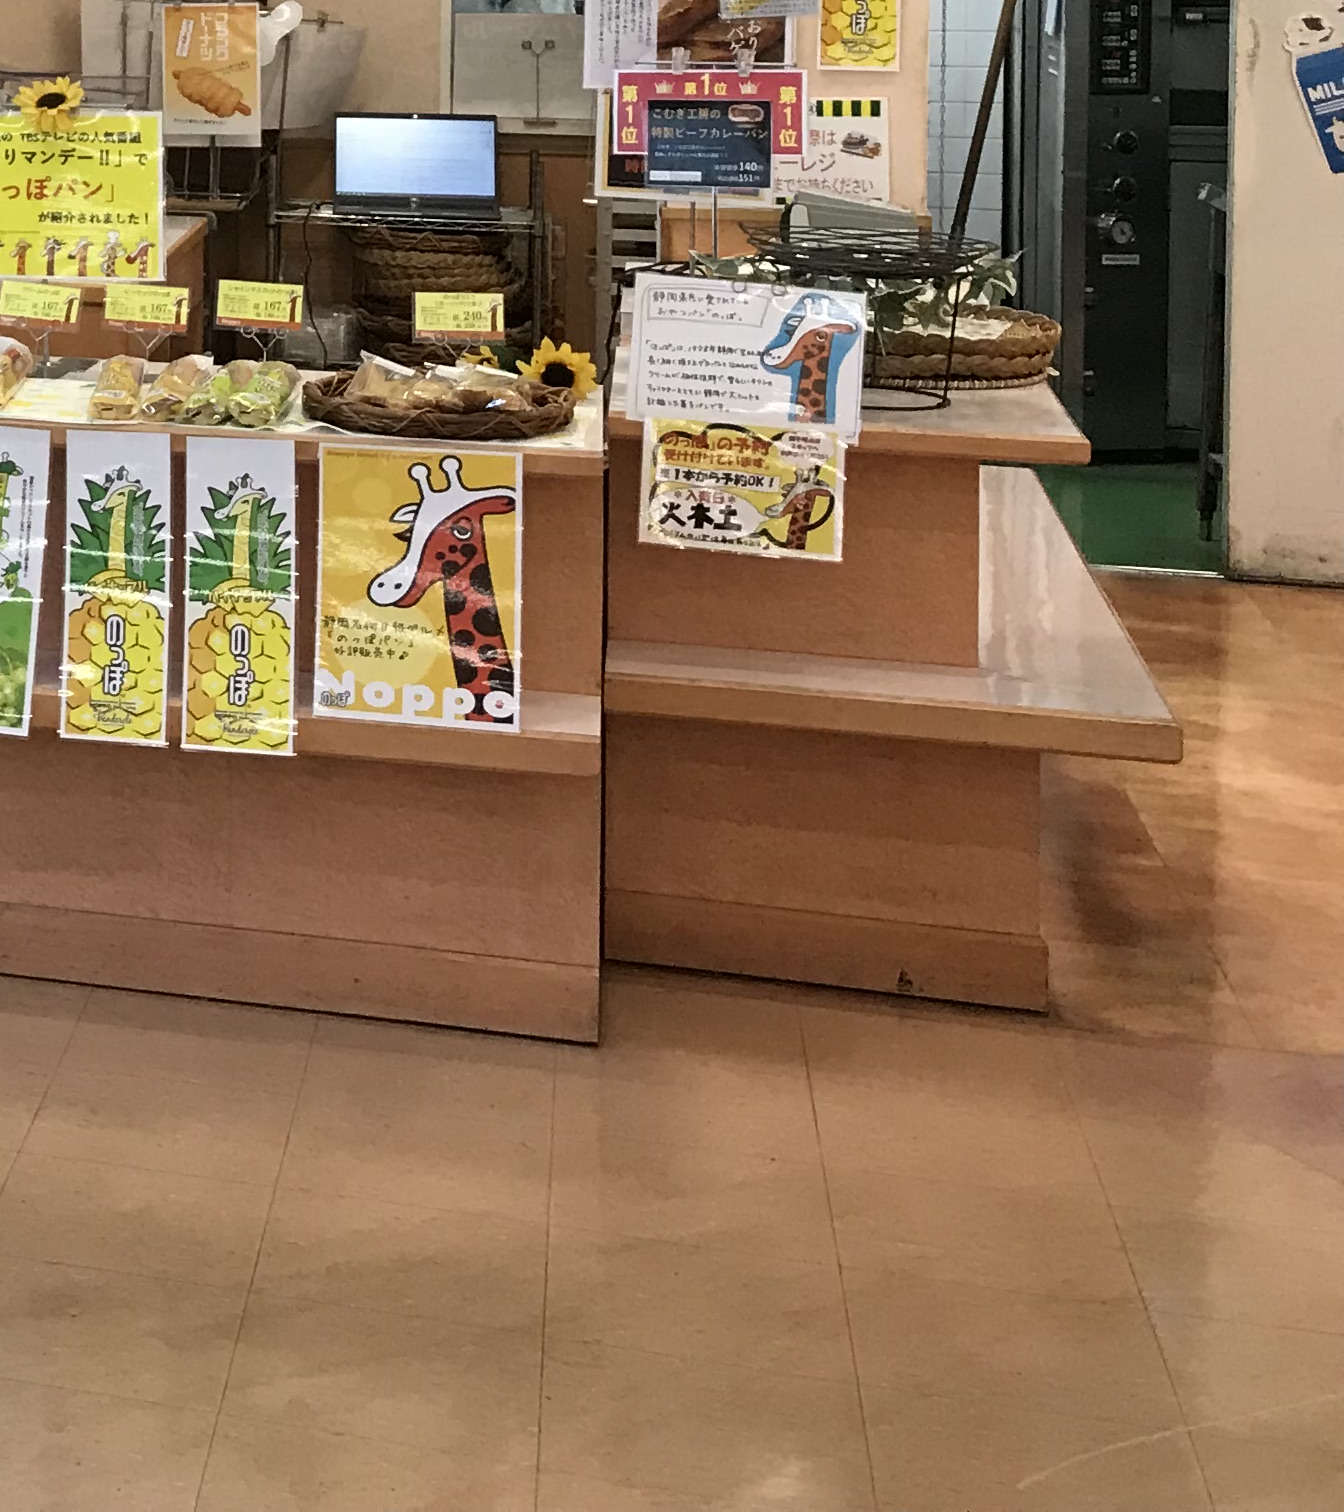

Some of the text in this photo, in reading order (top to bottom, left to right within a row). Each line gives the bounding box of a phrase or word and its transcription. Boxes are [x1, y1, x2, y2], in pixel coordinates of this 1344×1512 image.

[684, 73, 728, 96] 第1位
[1307, 79, 1344, 102] MIL
[622, 84, 639, 144] 第1位
[778, 85, 798, 147] 第1位
[658, 502, 743, 532] 火木土
[103, 614, 129, 696] のっぽ
[228, 624, 254, 707] のっぽ
[316, 668, 515, 722] Noppo
